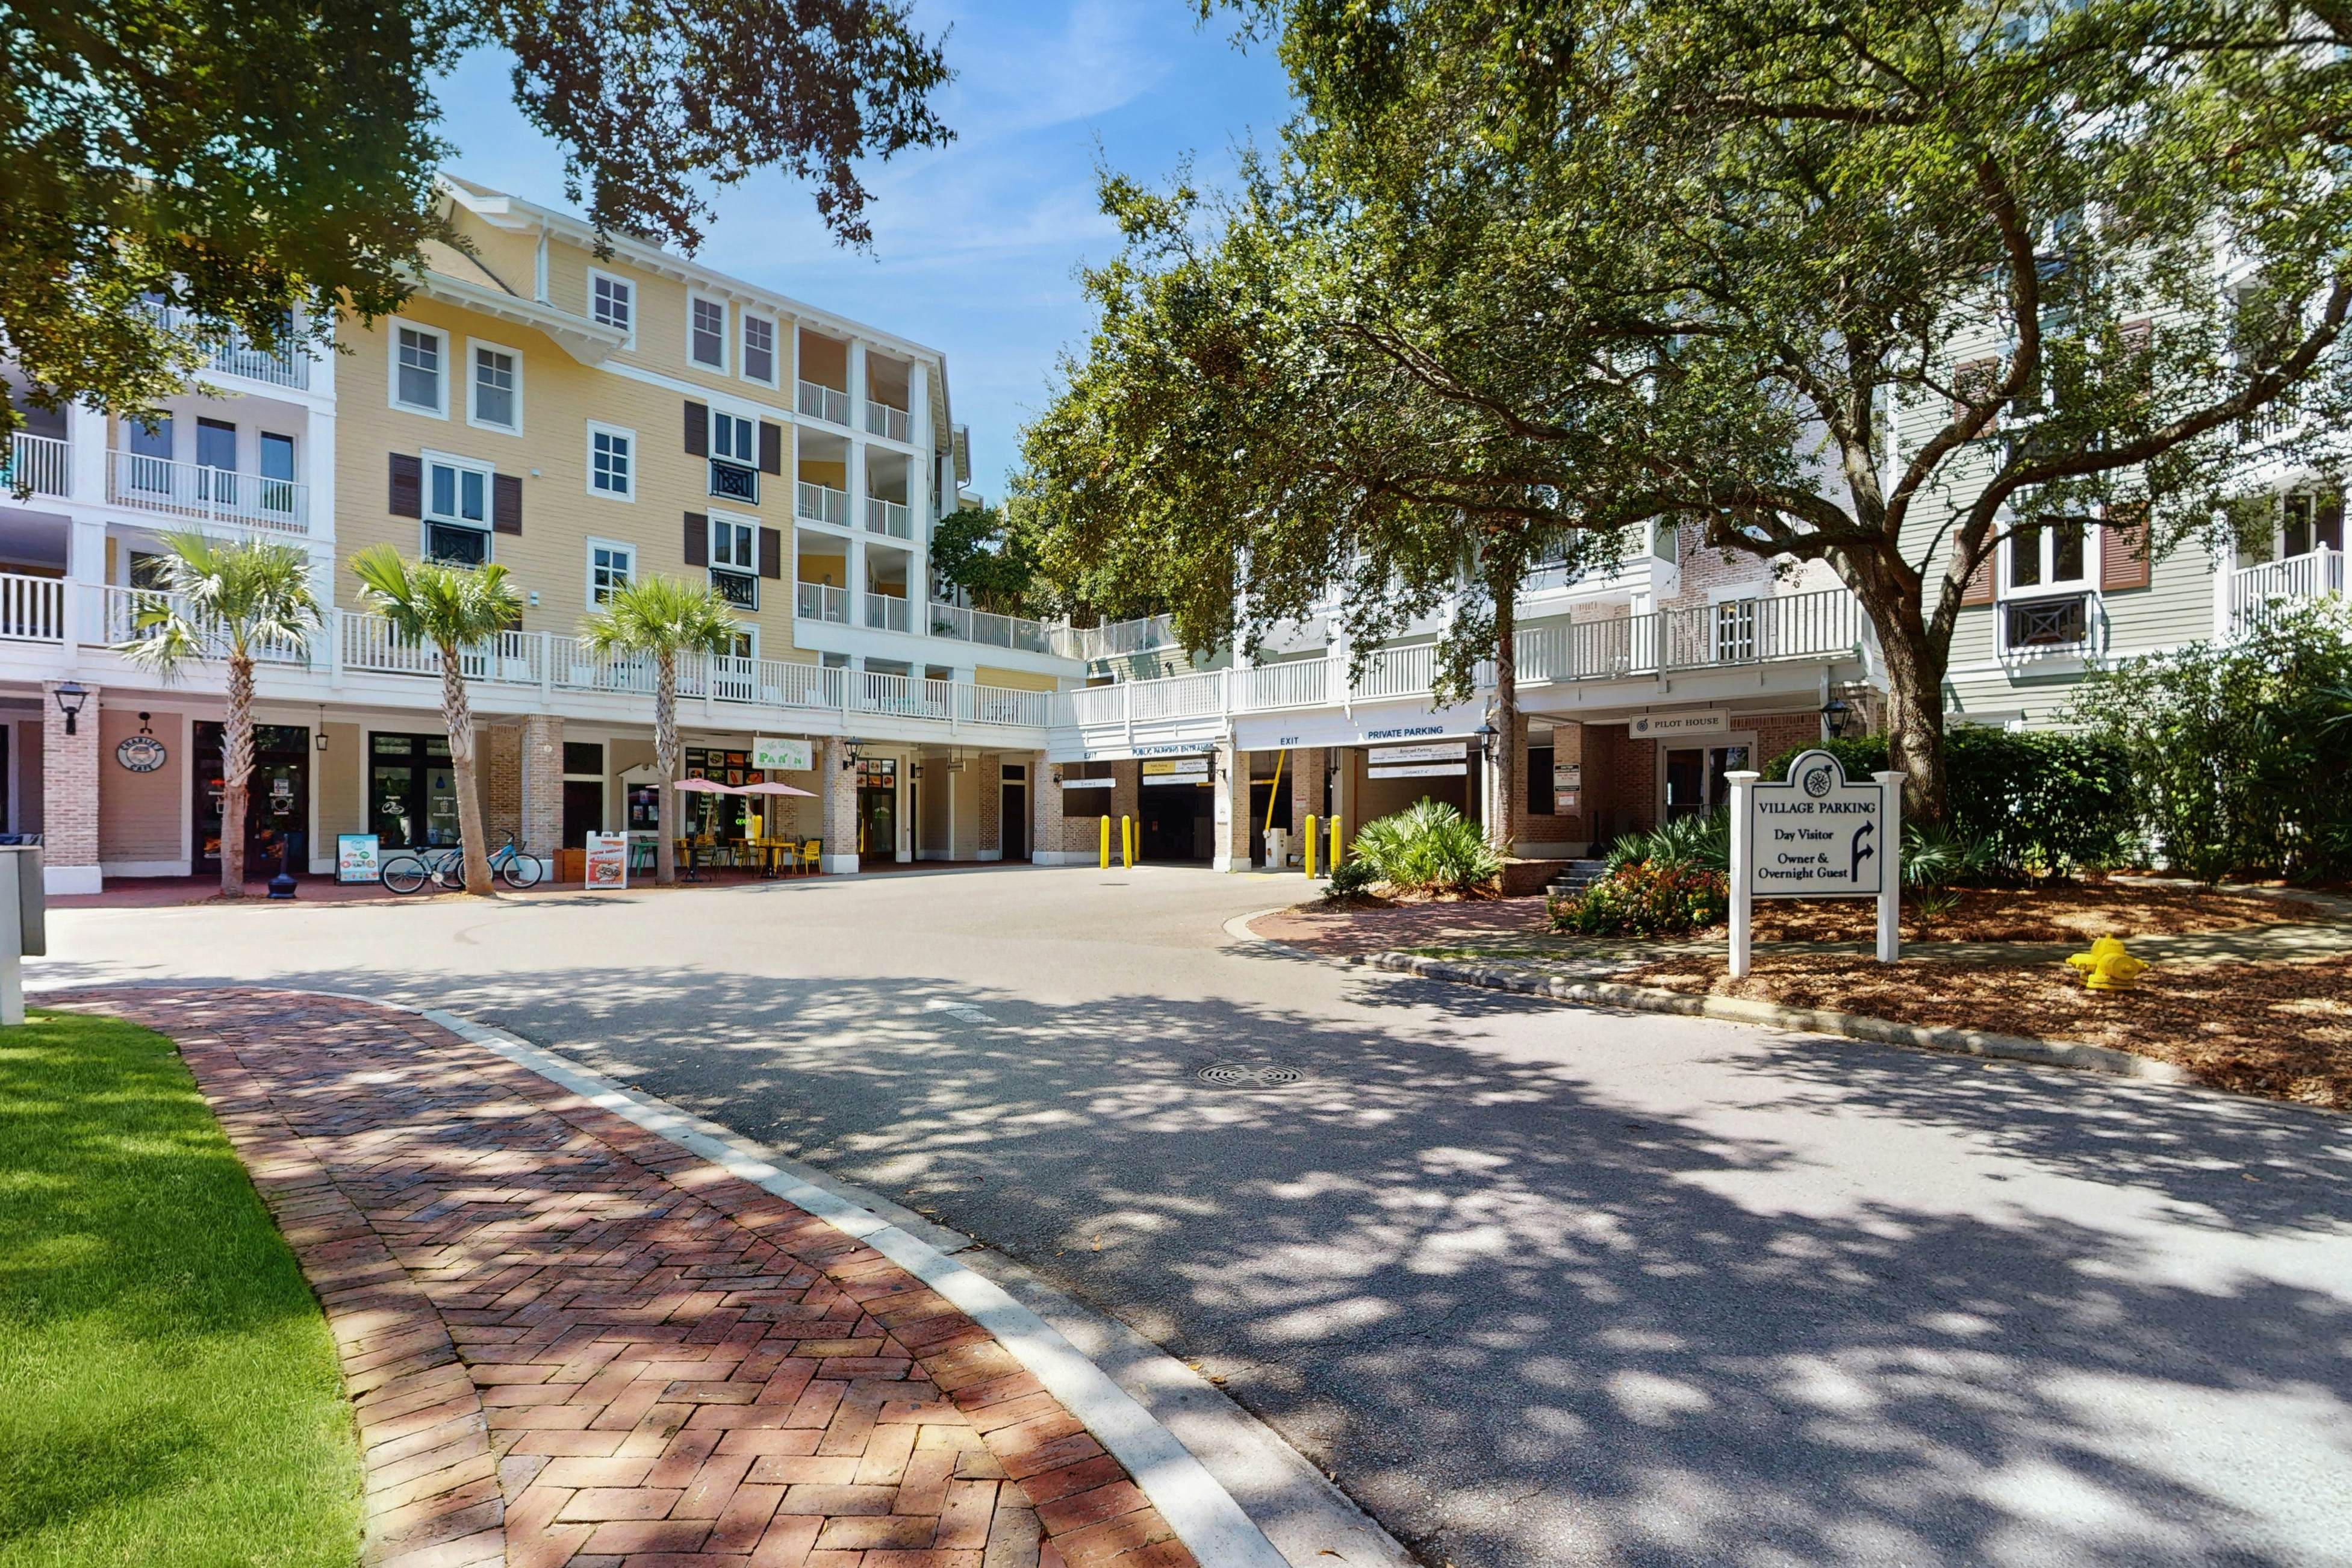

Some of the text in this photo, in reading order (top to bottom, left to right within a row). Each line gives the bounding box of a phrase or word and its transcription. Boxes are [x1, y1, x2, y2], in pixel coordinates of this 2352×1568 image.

[1686, 717, 1719, 726] HOUSE
[1368, 726, 1443, 739] PRIVATE PARKING
[120, 738, 164, 751] CHARLIE'S
[1280, 736, 1299, 745] EXIT
[1084, 751, 1098, 759] EXIT
[1133, 747, 1152, 756] PUBLIC
[1154, 745, 1178, 754] PARKING
[1759, 803, 1876, 813] VILLAGE PARKING
[1774, 829, 1834, 842] Day Visitor
[1778, 853, 1829, 864] Owner &
[1758, 866, 1847, 880] Overnight Guest
